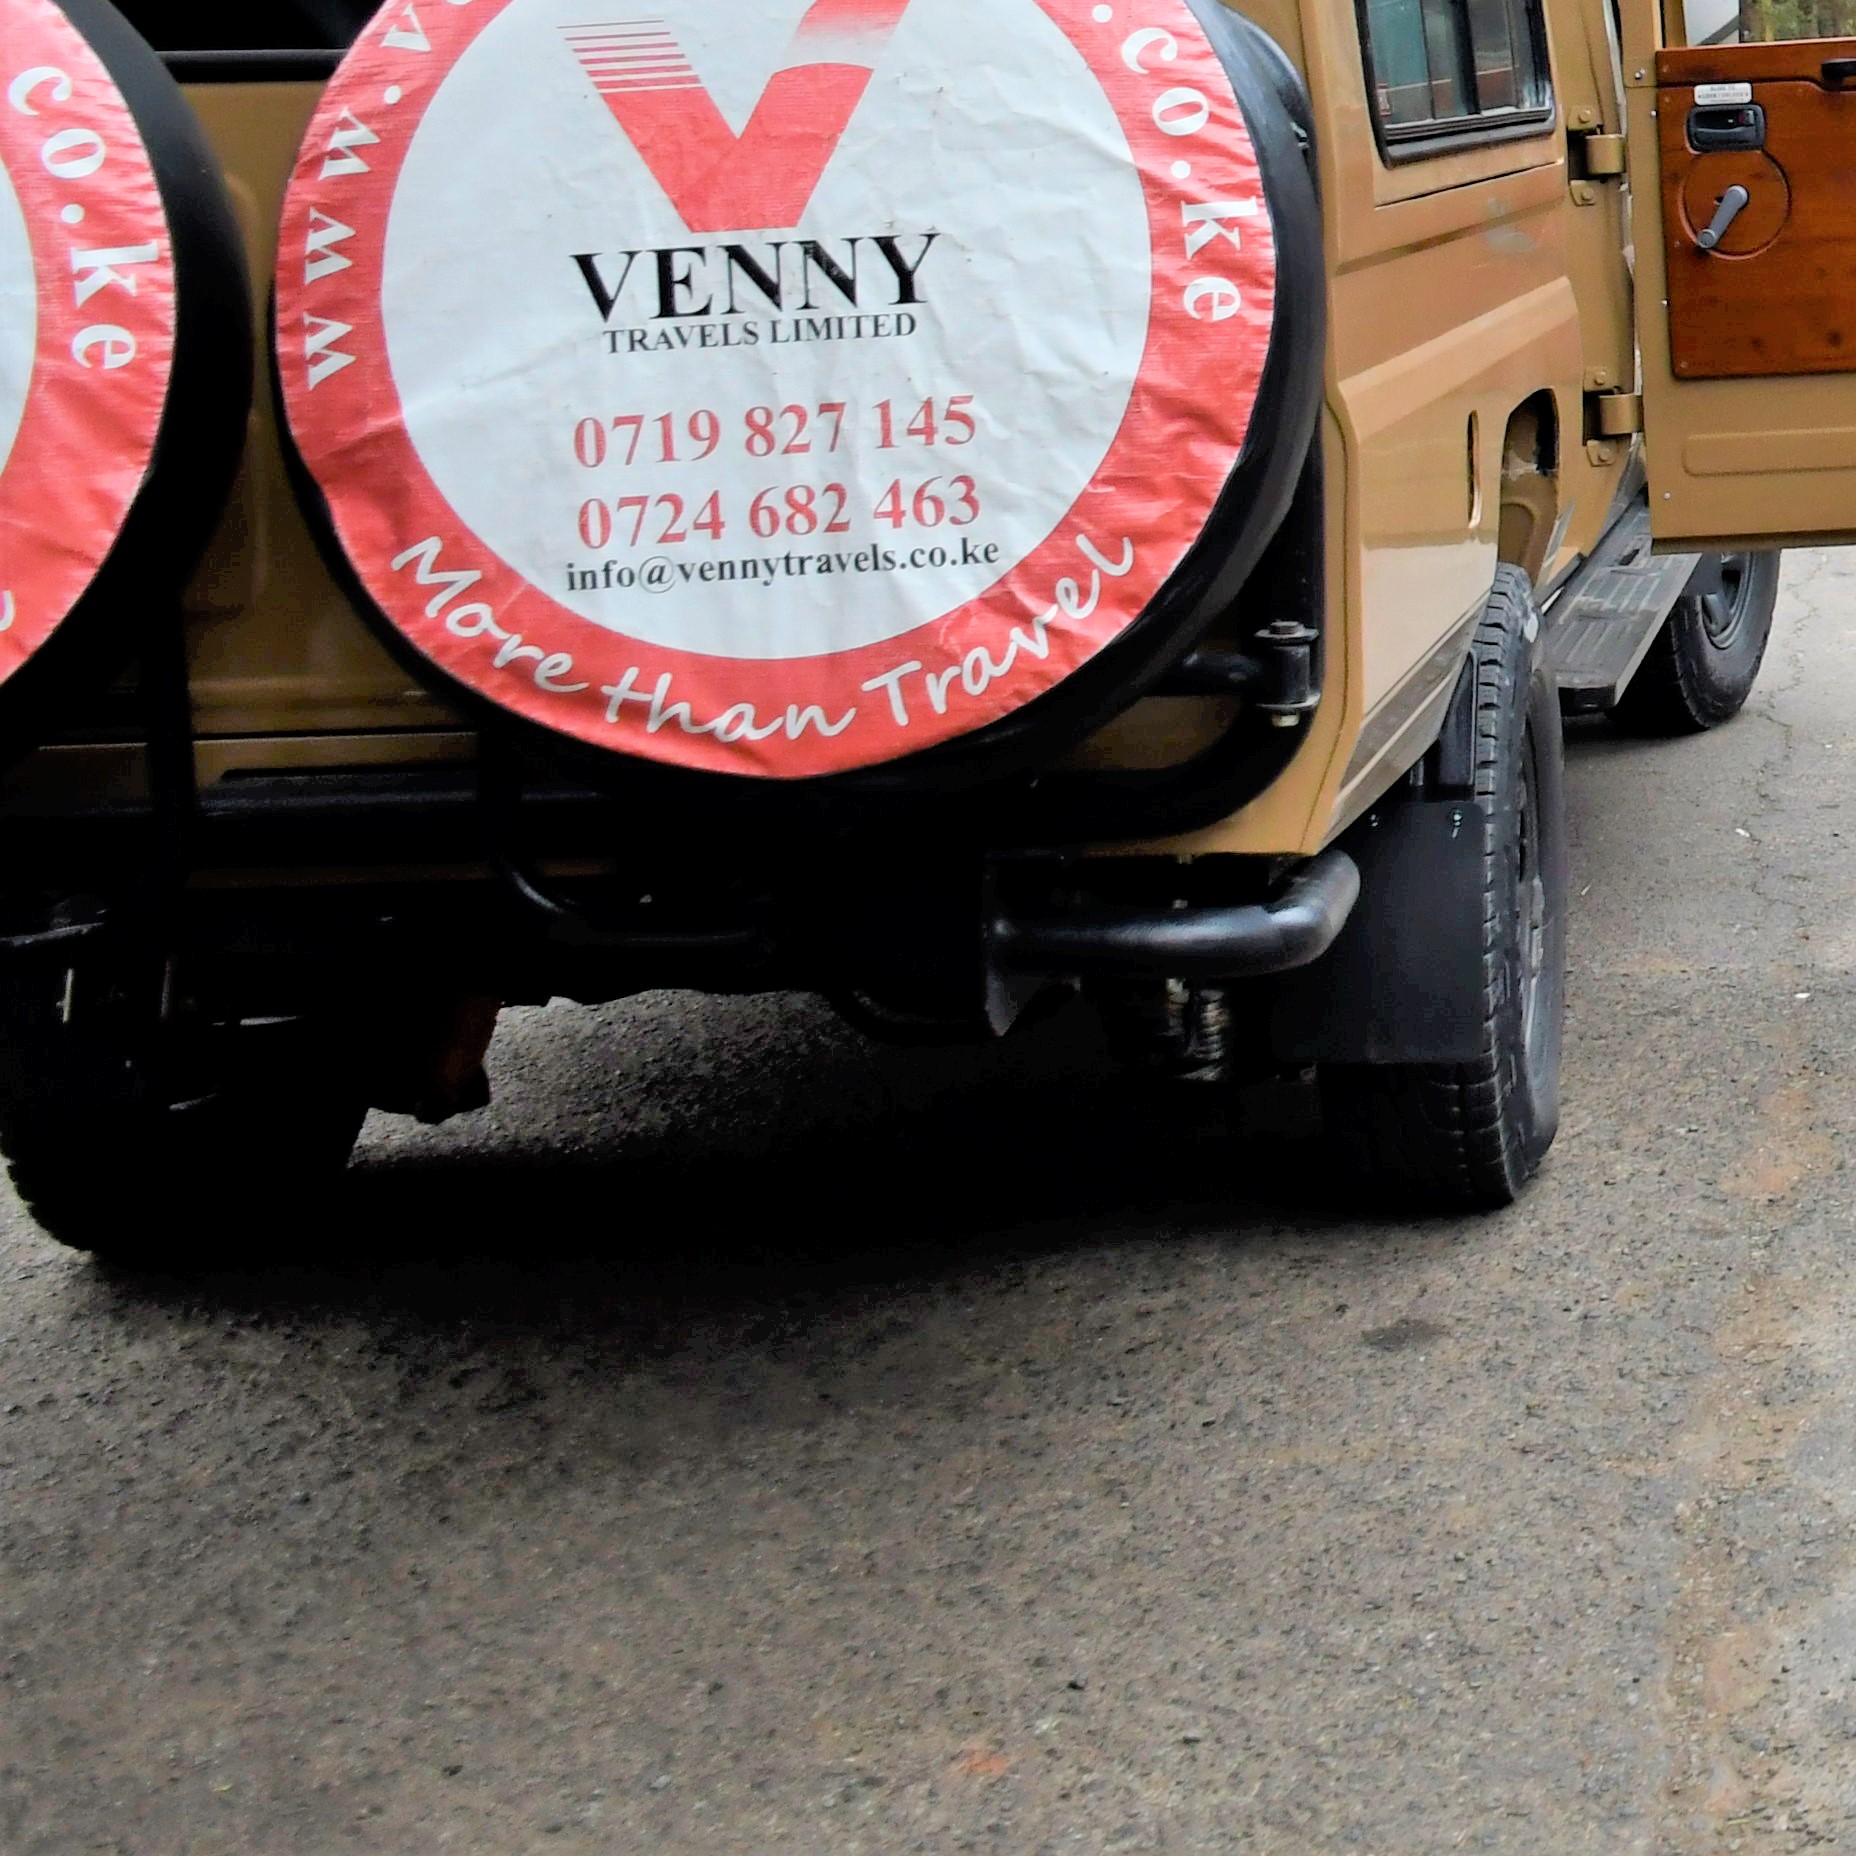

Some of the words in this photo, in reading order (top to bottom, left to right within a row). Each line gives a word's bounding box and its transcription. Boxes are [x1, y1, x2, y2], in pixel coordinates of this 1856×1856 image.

[570, 232, 941, 323] VENNY
[602, 320, 760, 355] TRAVELS
[770, 312, 917, 343] LIMITED
[573, 408, 721, 468] 0719
[743, 401, 847, 457] 827
[873, 394, 976, 449] 145
[578, 489, 726, 549] 0724
[748, 482, 852, 538] 682
[873, 474, 981, 529] 463
[566, 537, 1000, 593] info@vennytravels.co.ke
[390, 534, 589, 694] More
[601, 664, 858, 747] than
[860, 532, 1136, 729] Travel
